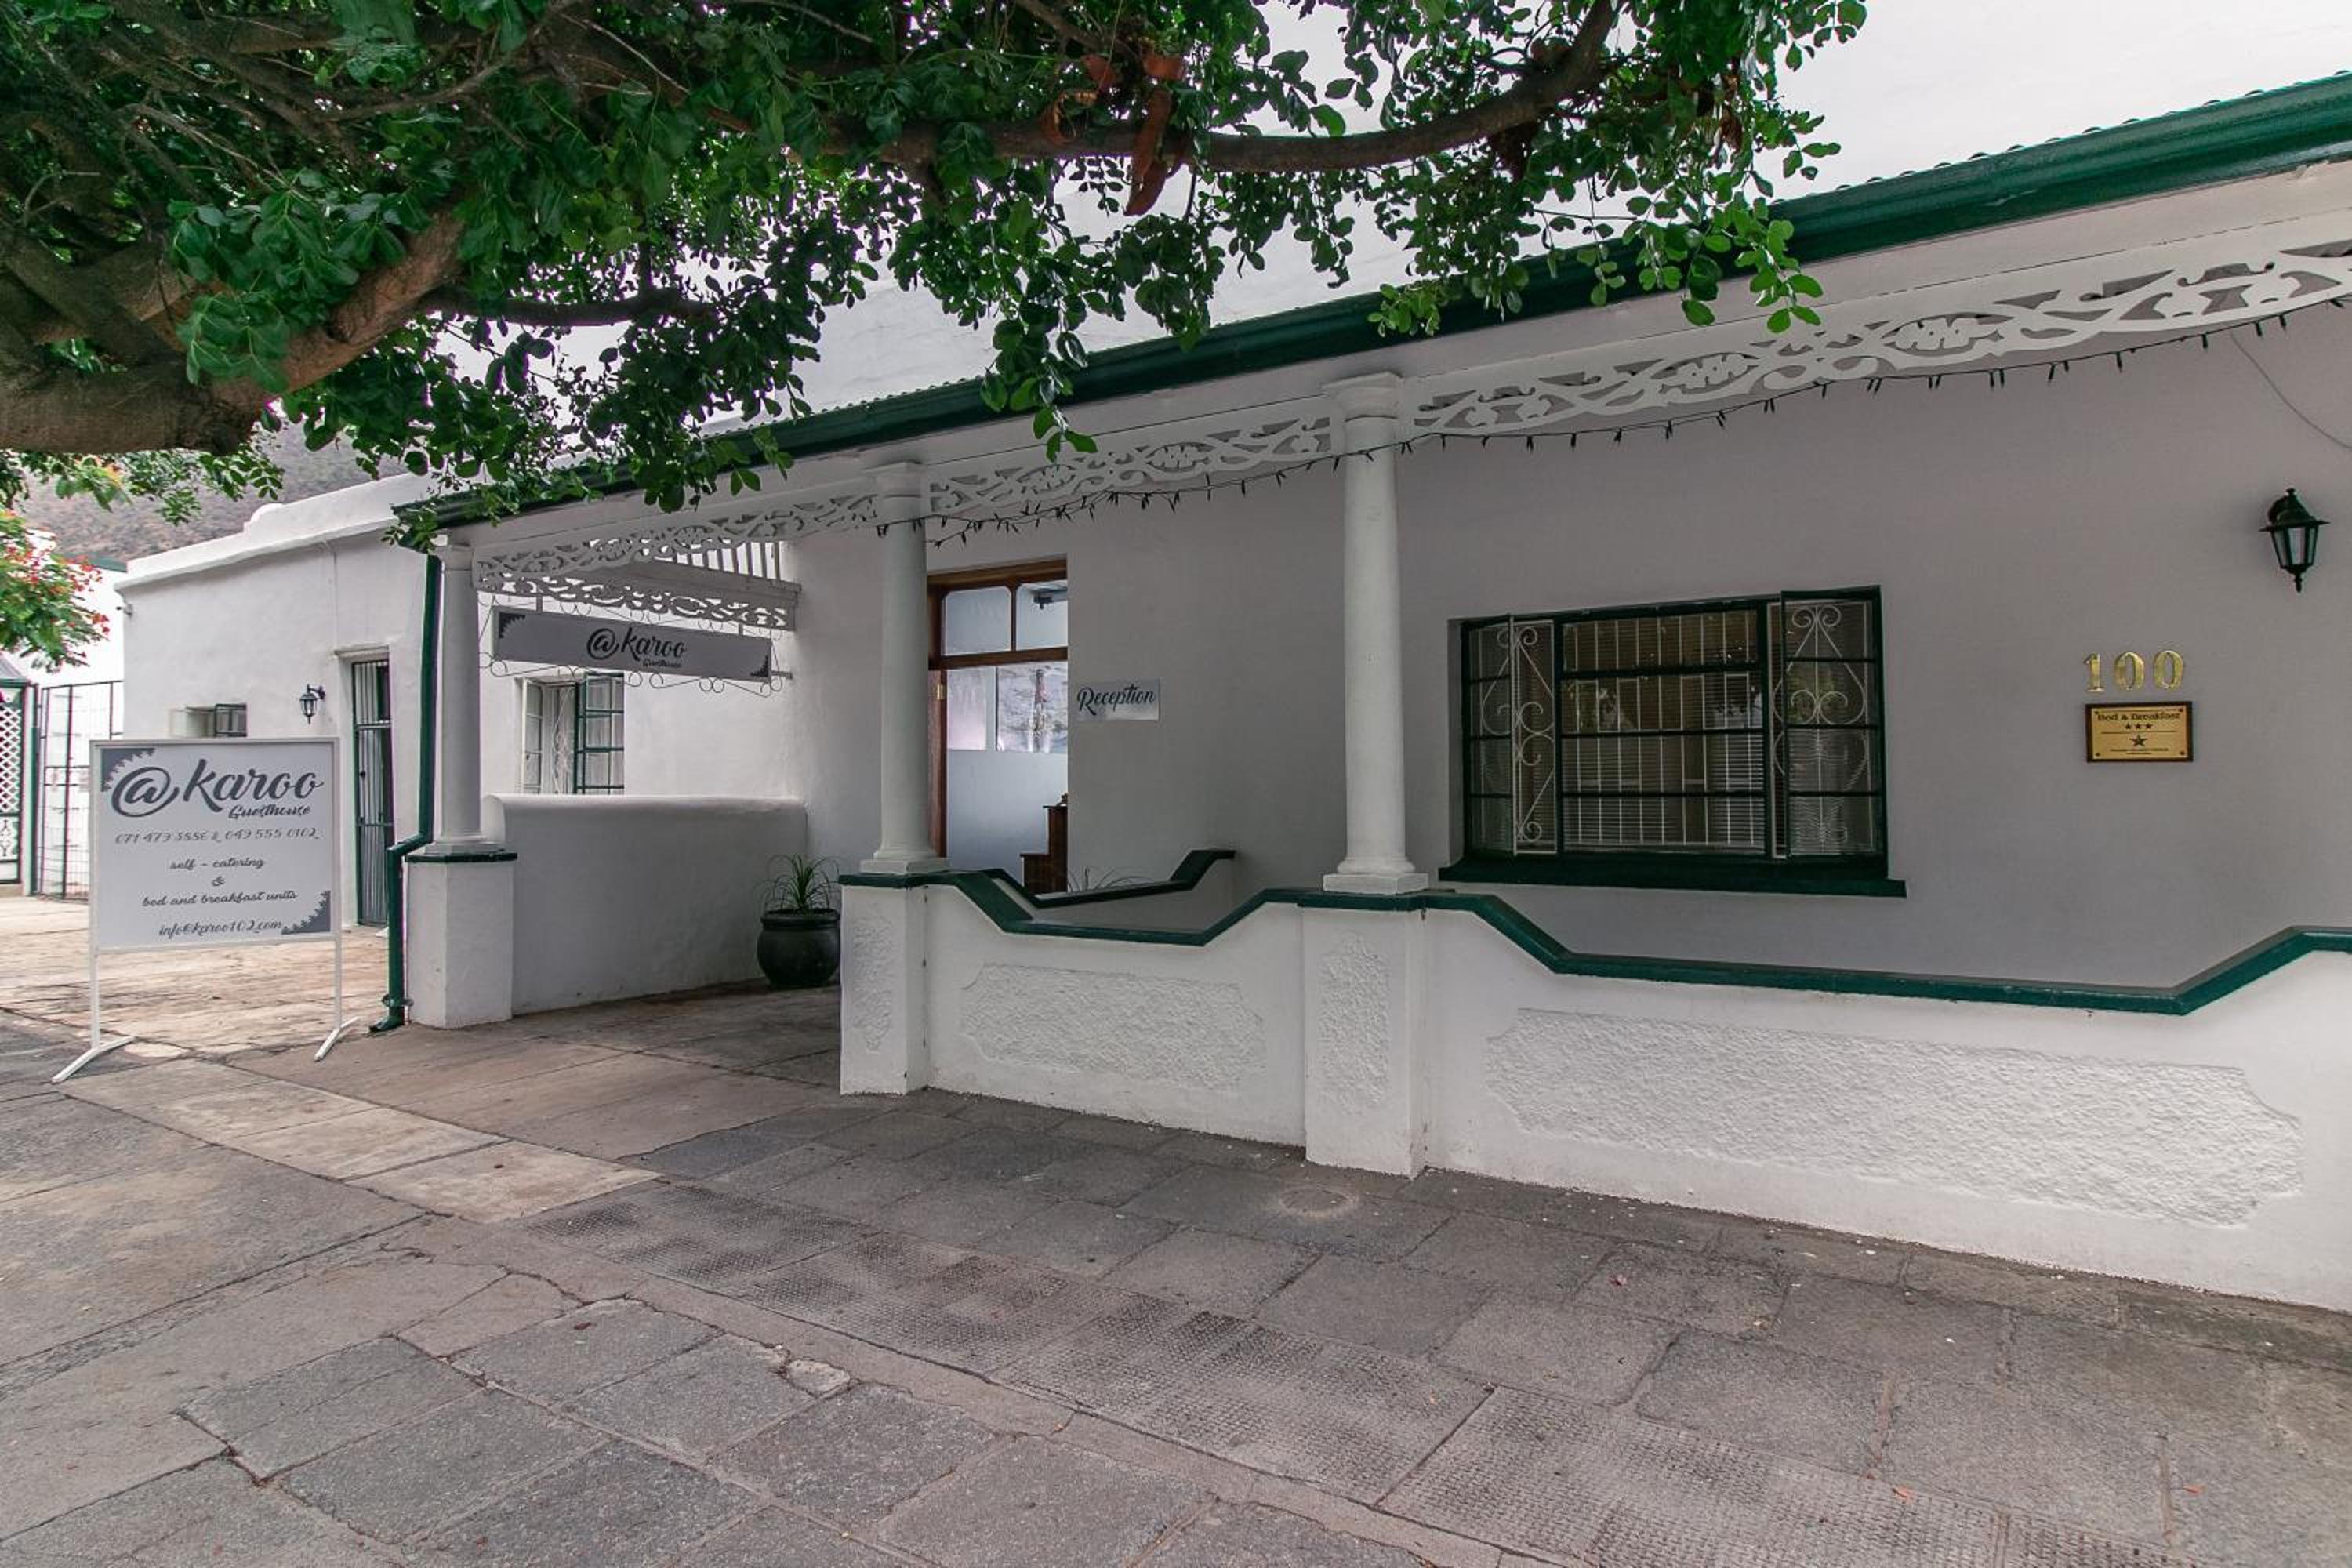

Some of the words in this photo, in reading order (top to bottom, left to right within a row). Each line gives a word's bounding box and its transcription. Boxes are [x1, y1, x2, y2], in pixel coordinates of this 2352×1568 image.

[586, 627, 685, 661] @karoo
[2082, 650, 2183, 692] 100
[1077, 684, 1155, 715] Reception
[111, 758, 325, 818] @karoo
[228, 804, 311, 818] Guesthouse
[212, 857, 264, 869] catering
[212, 876, 226, 887] &
[142, 895, 167, 907] bed
[169, 895, 197, 906] and
[201, 891, 265, 904] breakfast
[267, 890, 298, 901] units
